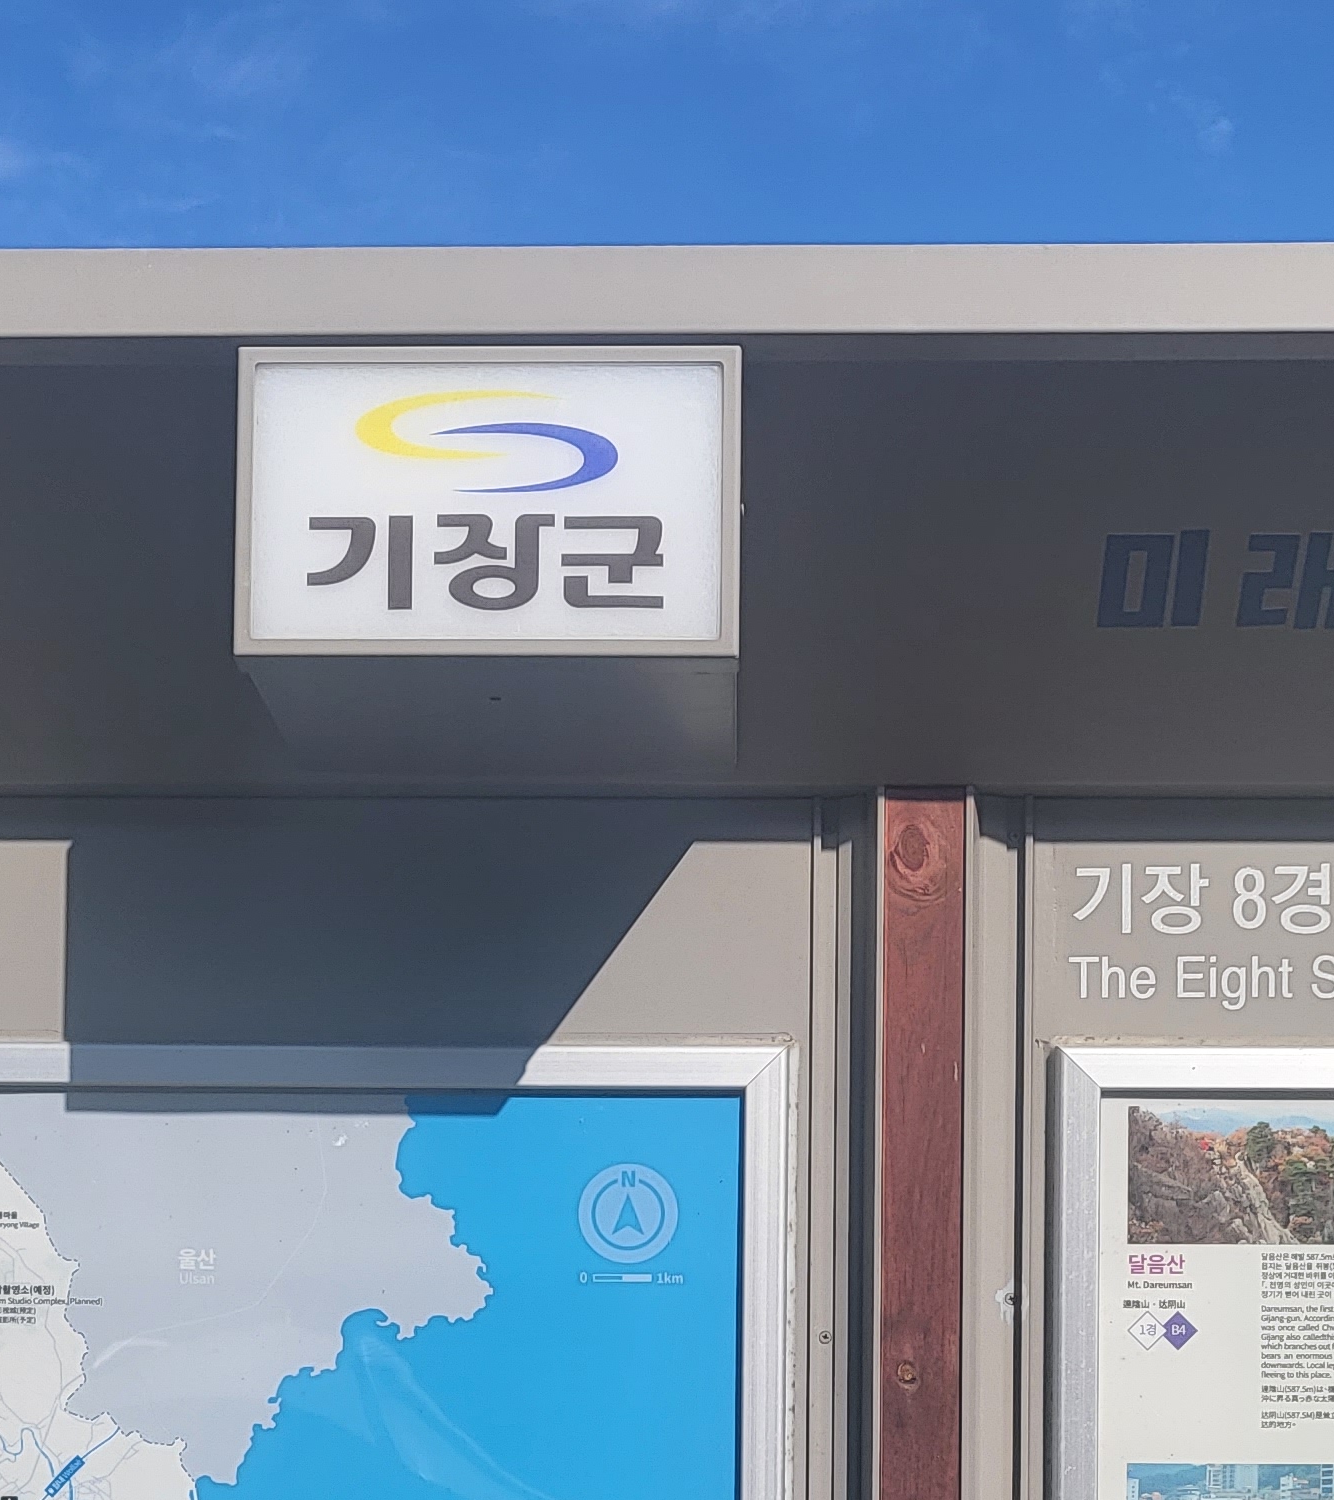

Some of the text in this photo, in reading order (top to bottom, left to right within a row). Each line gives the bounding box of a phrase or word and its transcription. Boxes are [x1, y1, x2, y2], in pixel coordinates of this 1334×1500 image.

[307, 514, 663, 611] 기장군
[1072, 862, 1332, 935] 기장 8경
[1067, 955, 1157, 1000] The
[1175, 954, 1294, 1011] Eight
[622, 1171, 635, 1187] N
[178, 1247, 216, 1271] 울산
[1129, 1252, 1185, 1274] 달음산
[180, 1272, 214, 1285] Ulsan
[580, 1272, 587, 1283] 0
[657, 1272, 683, 1284] 1km
[1139, 1322, 1158, 1338] 1경
[1170, 1324, 1186, 1336] B4
